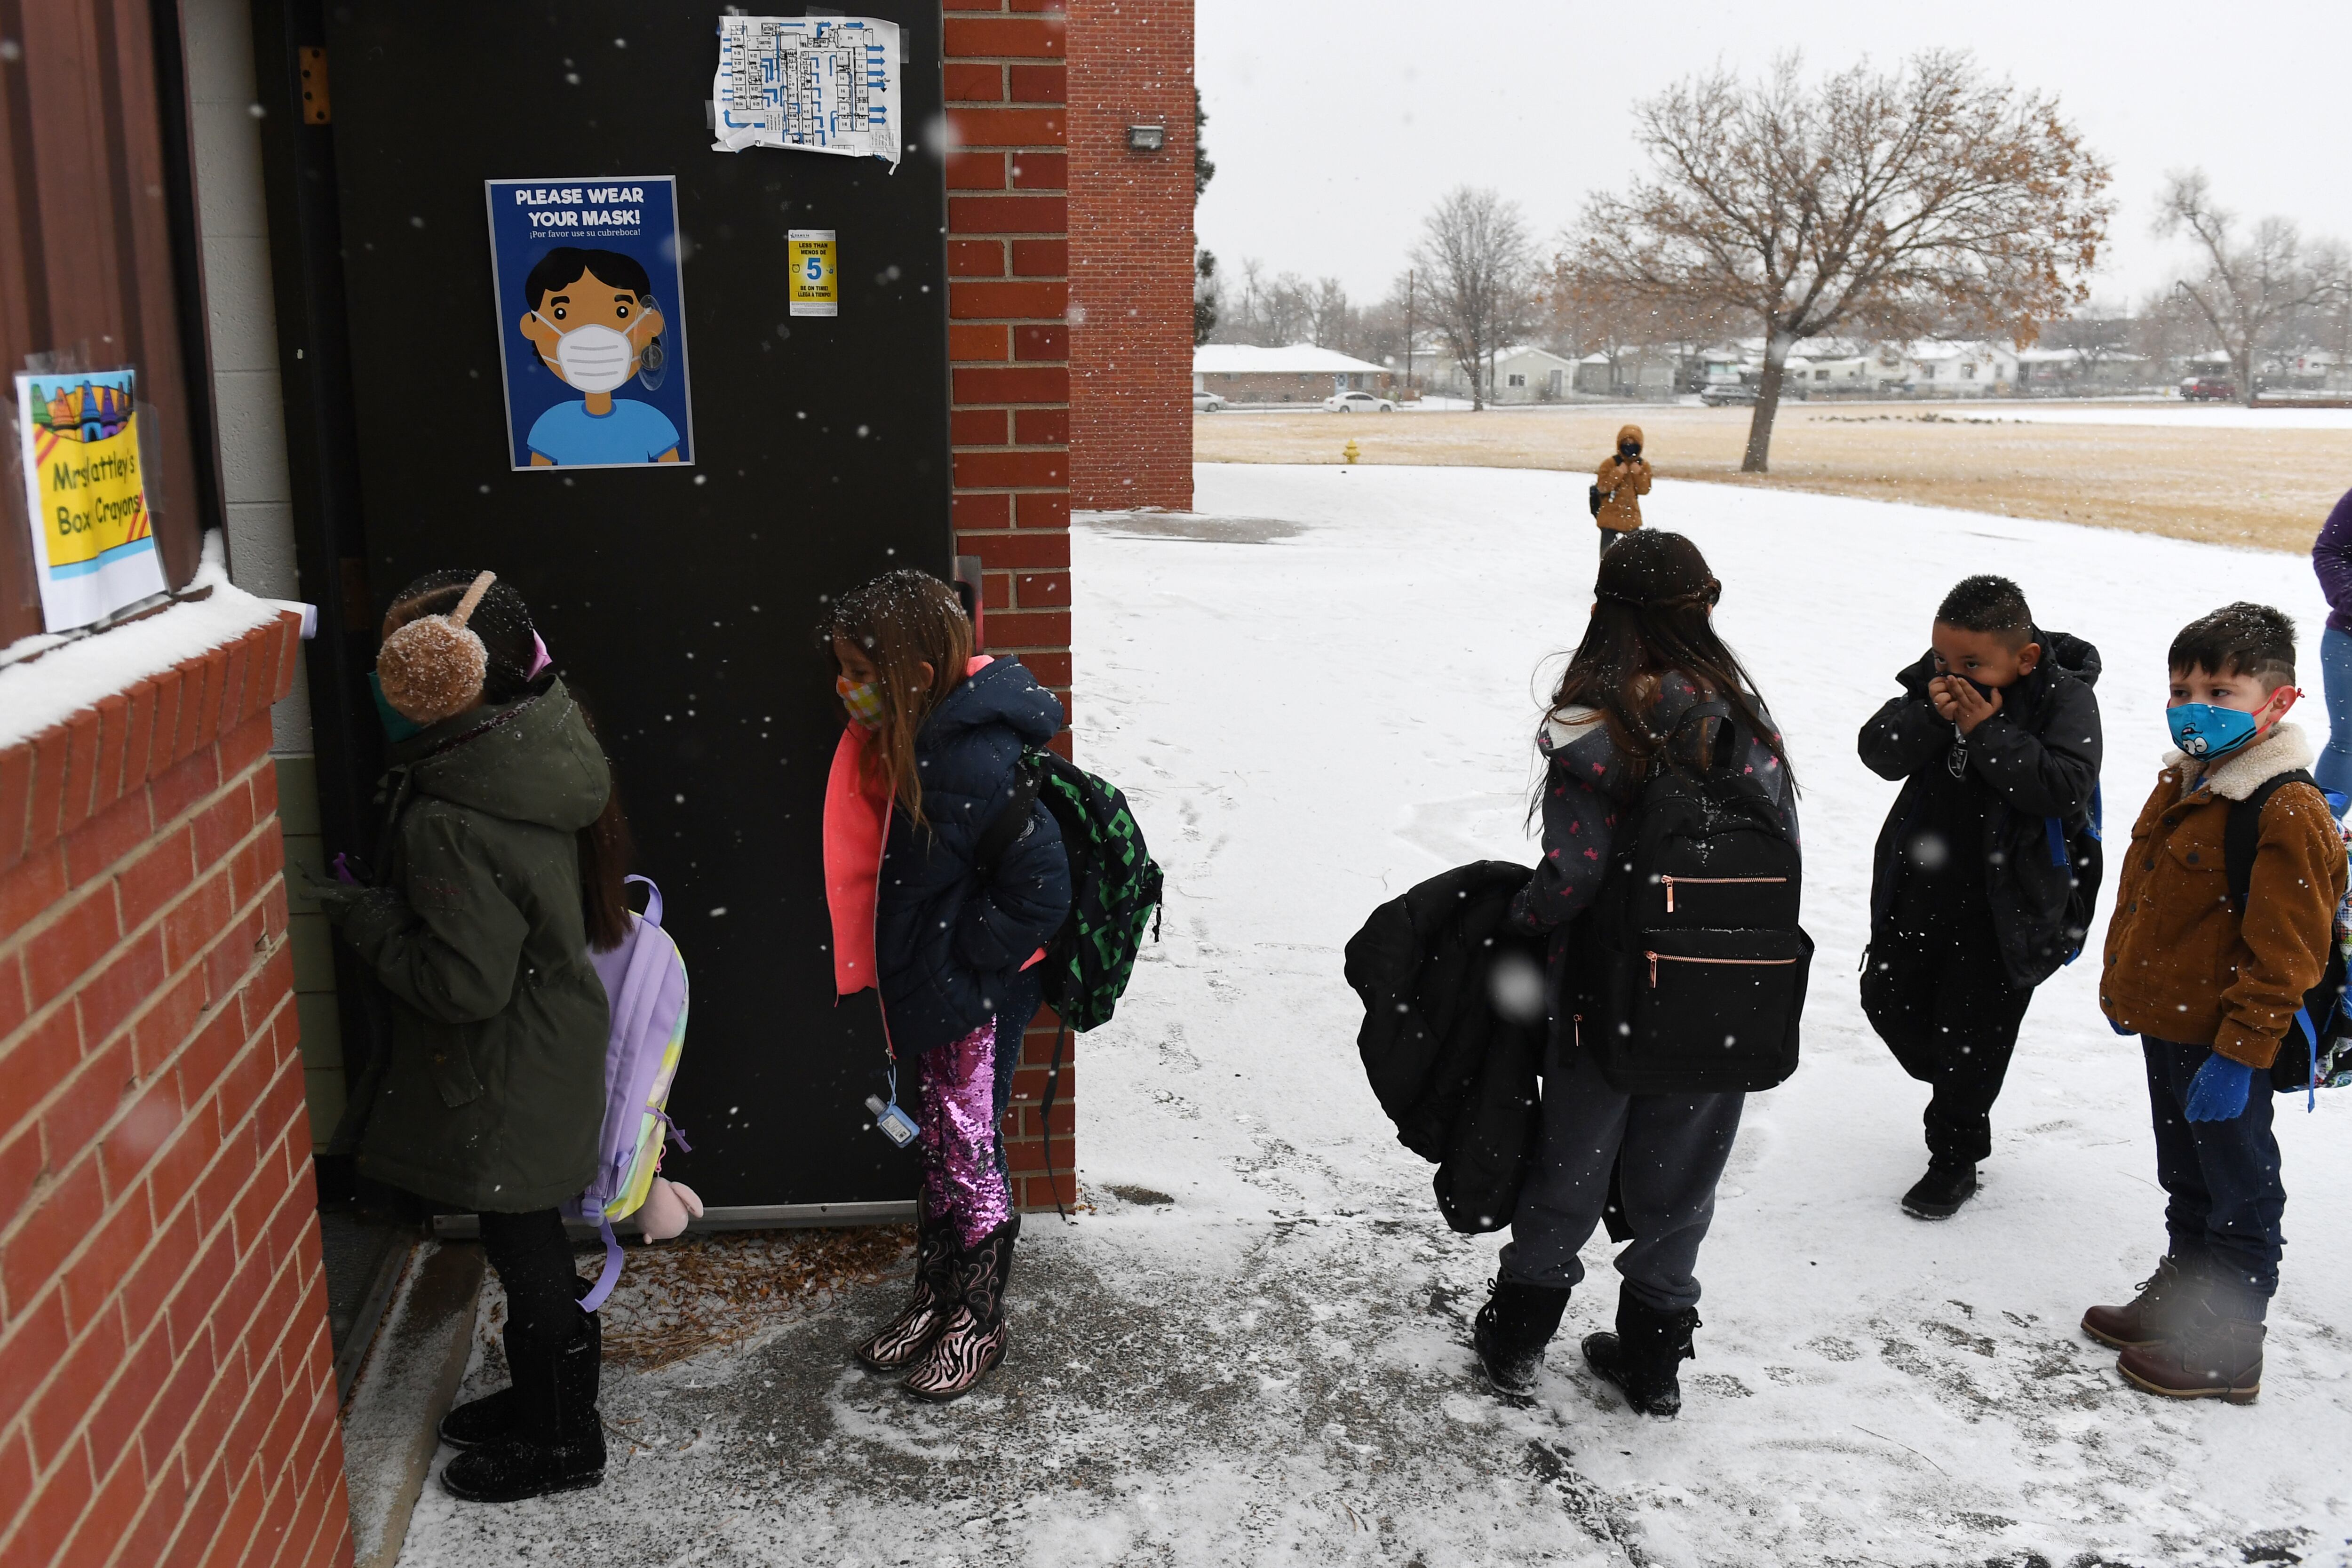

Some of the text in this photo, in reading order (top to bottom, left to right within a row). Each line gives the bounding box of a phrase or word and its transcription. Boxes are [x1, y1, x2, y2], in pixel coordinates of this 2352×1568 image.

[516, 187, 644, 205] PLEASE WEAR
[528, 210, 641, 227] YOUR MASK!
[530, 231, 546, 239] ¡Por
[597, 228, 641, 237] cubreboca!
[807, 257, 821, 280] 5
[57, 494, 141, 535] Box Crayons
